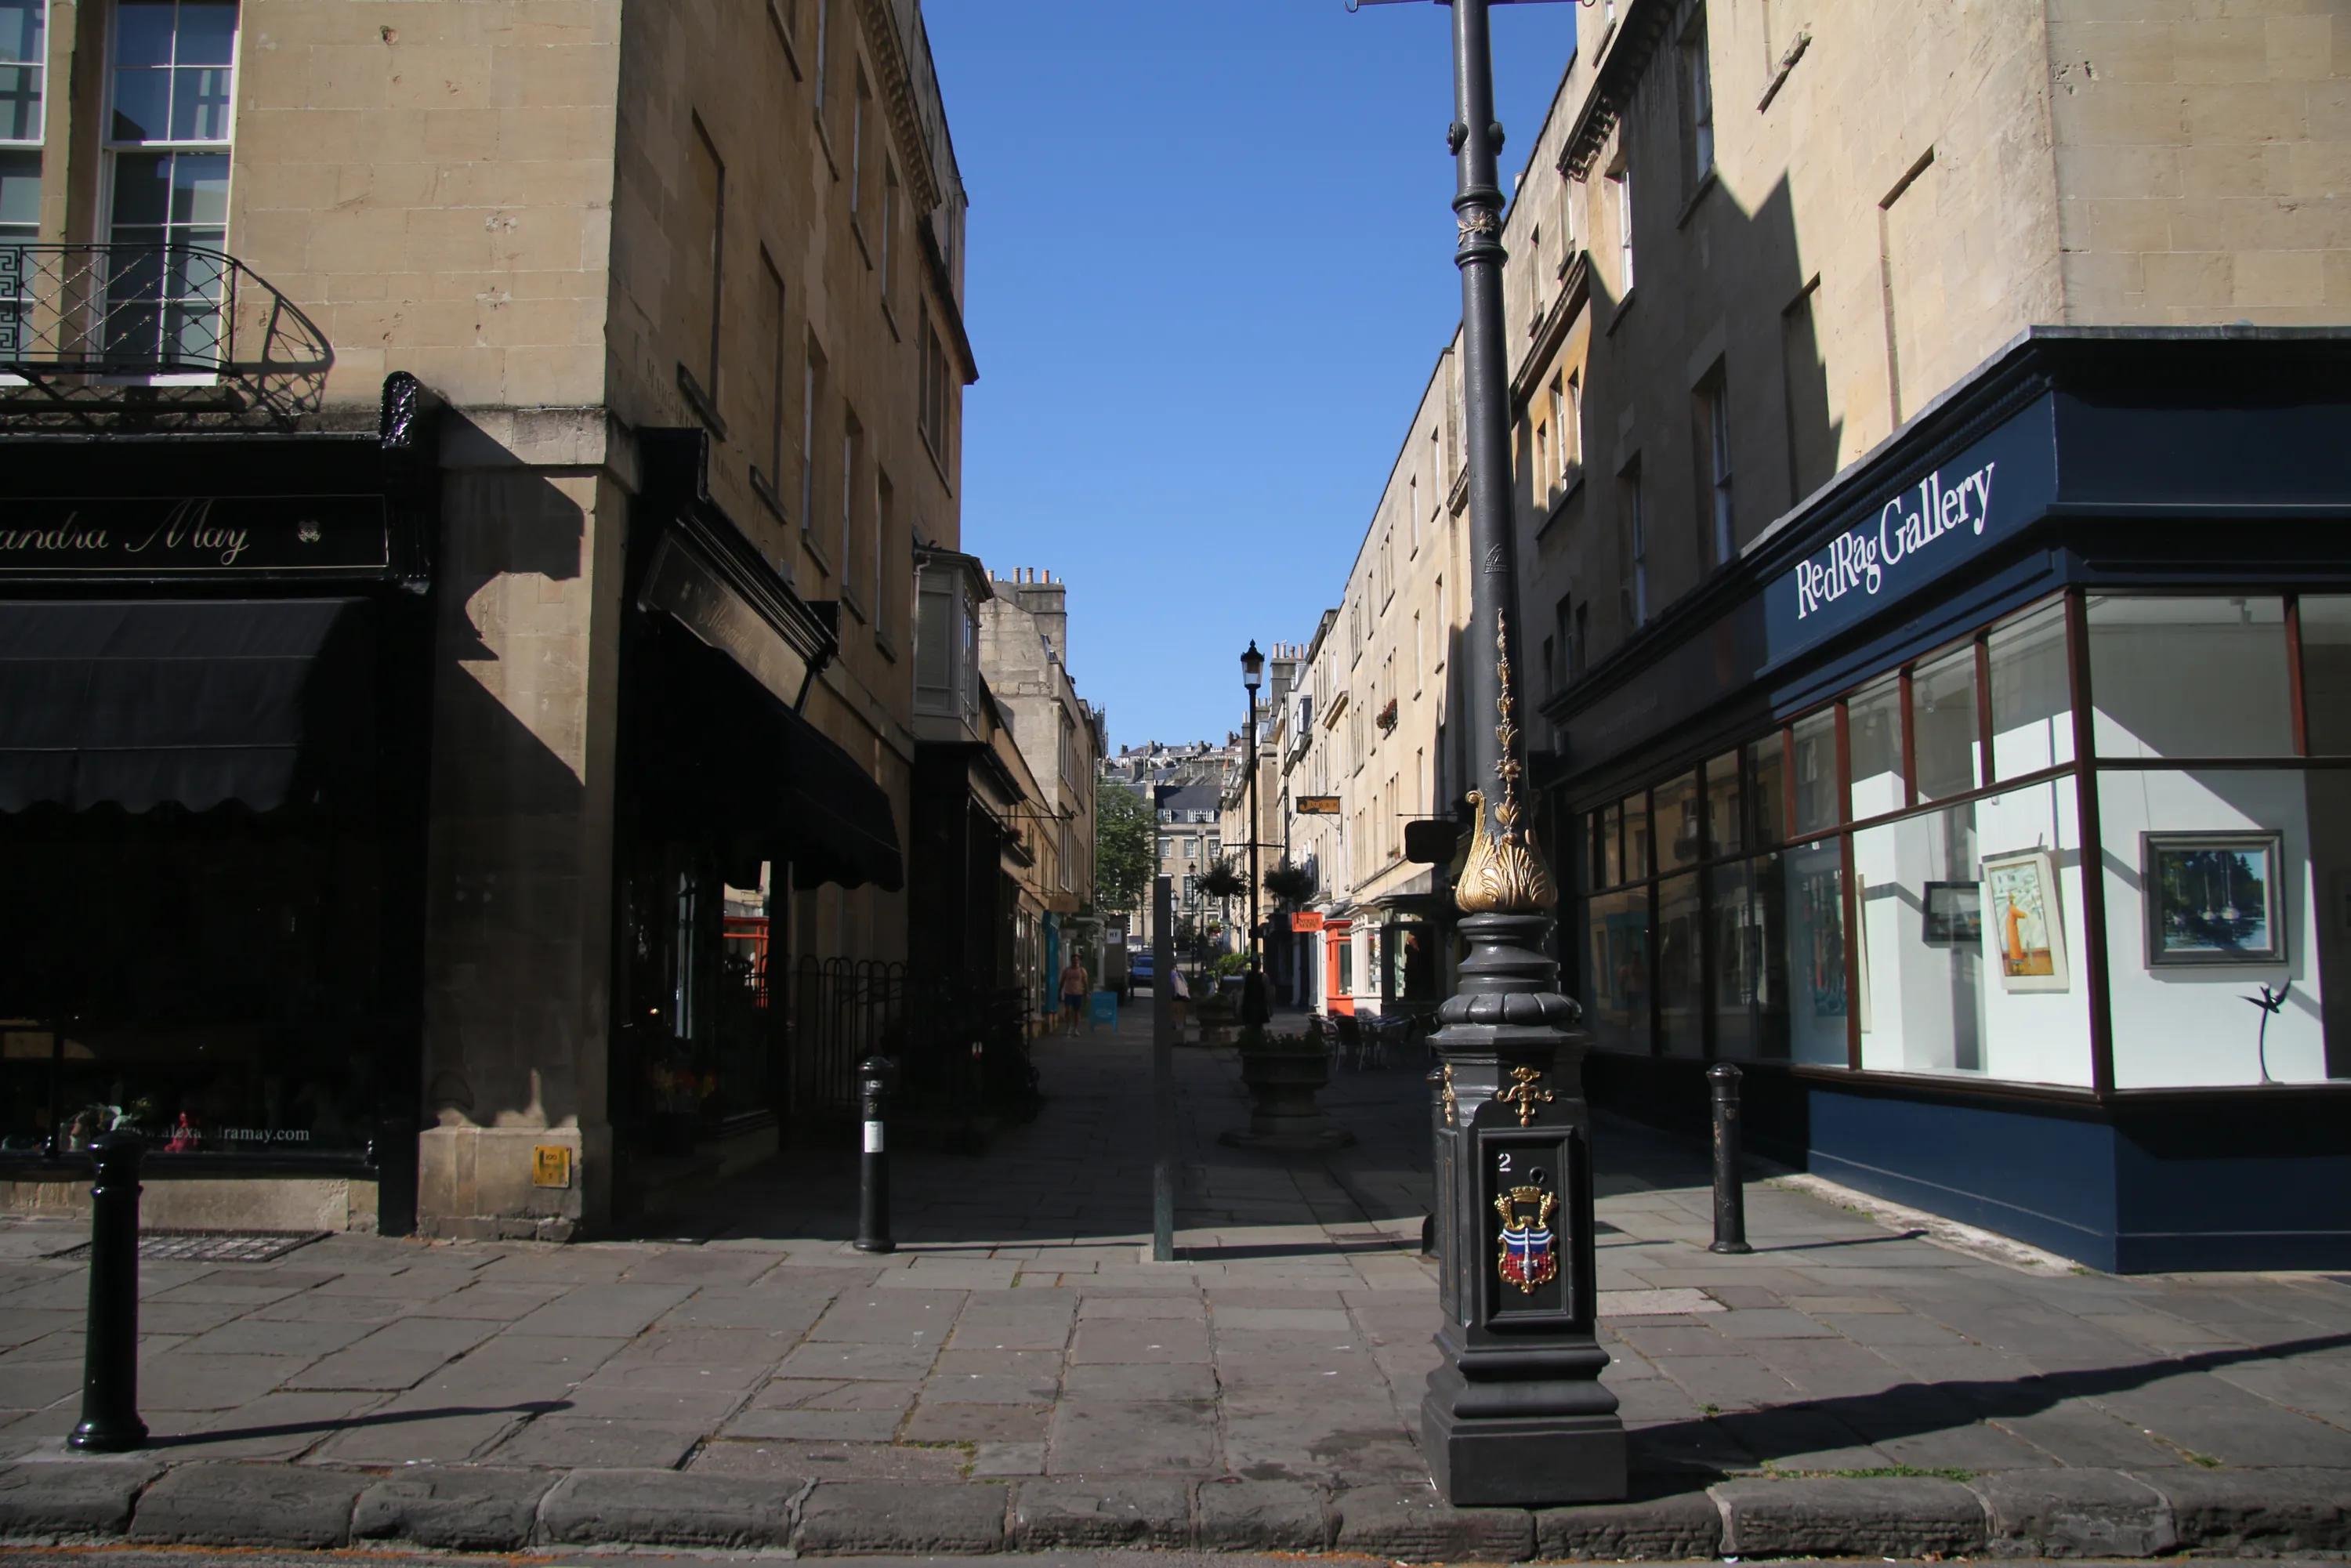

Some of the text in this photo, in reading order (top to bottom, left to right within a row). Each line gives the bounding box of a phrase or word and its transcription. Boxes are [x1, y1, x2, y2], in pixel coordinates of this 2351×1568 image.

[124, 496, 250, 566] May
[1795, 462, 1994, 620] RedRag Gallery
[1498, 1153, 1512, 1172] 2
